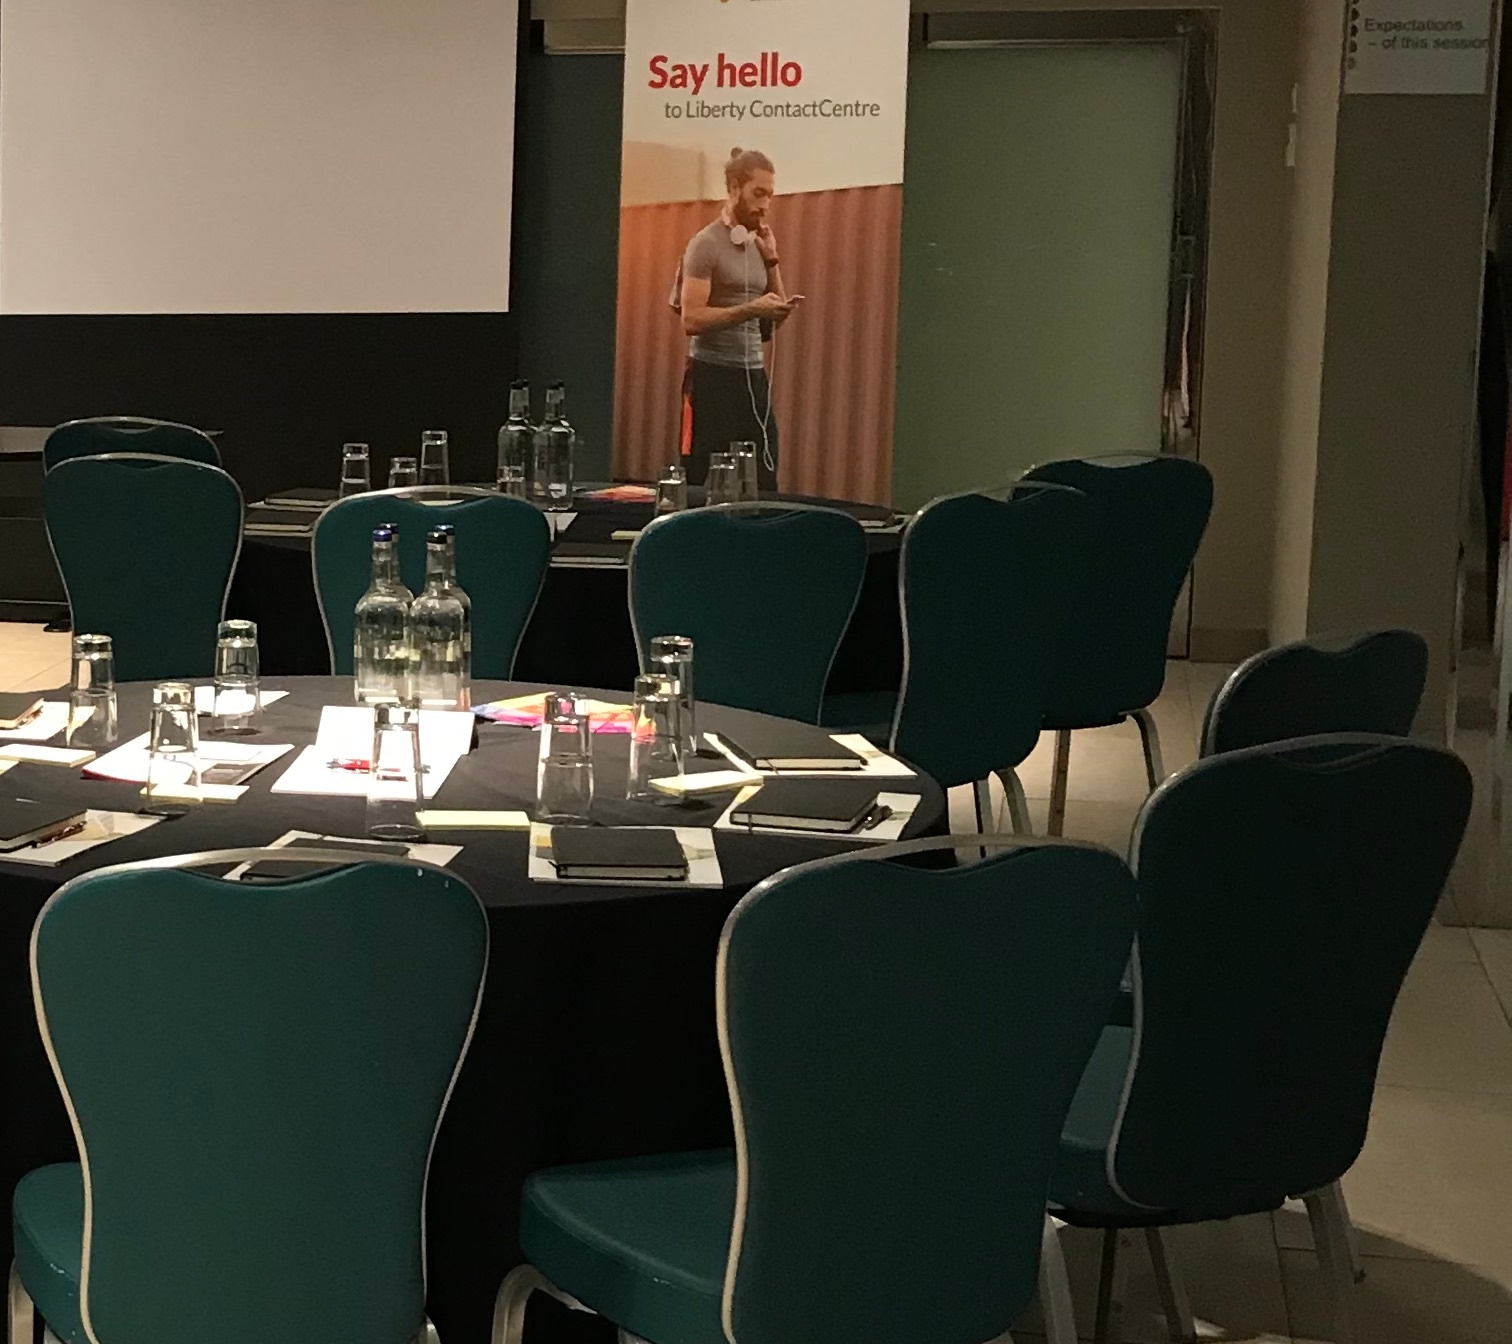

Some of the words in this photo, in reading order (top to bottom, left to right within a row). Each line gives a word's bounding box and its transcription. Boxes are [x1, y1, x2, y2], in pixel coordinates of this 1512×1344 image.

[1364, 18, 1464, 33] Expectations
[648, 54, 710, 96] Say
[717, 51, 802, 88] hello
[665, 102, 682, 119] to
[686, 100, 746, 121] Liberty
[749, 99, 880, 119] ContactCentre
